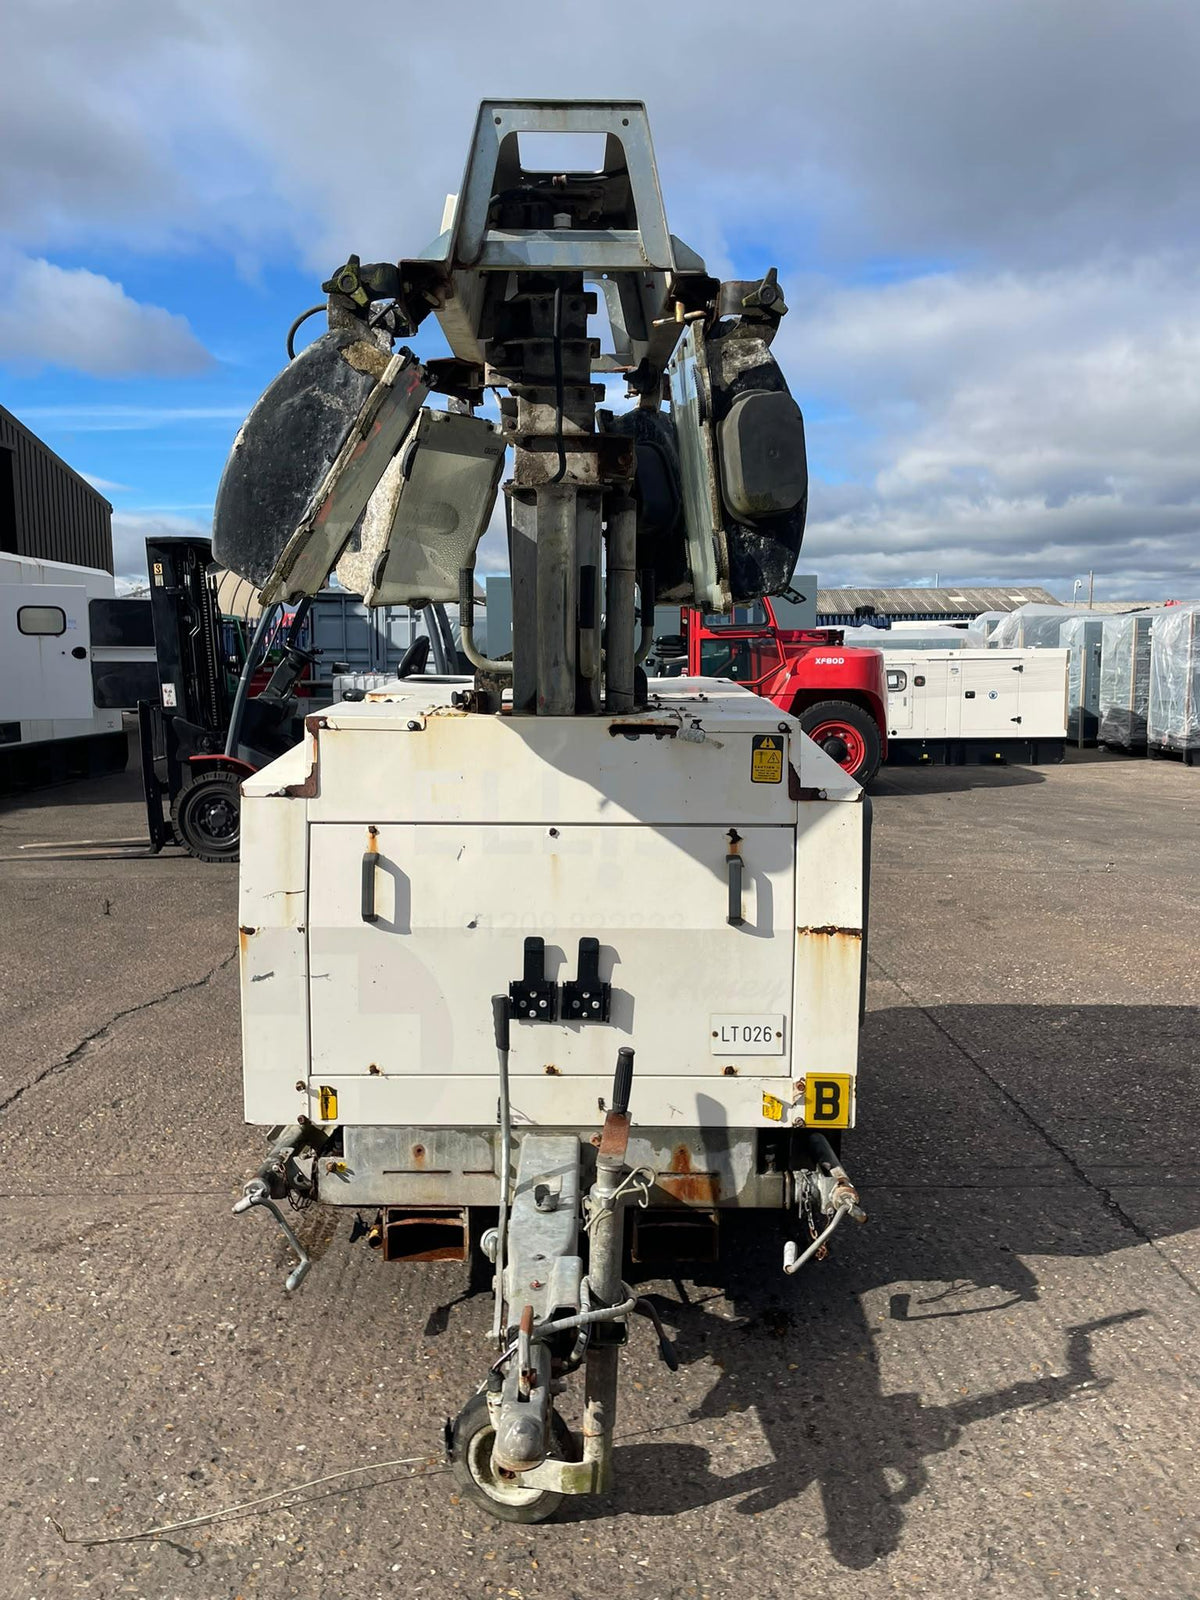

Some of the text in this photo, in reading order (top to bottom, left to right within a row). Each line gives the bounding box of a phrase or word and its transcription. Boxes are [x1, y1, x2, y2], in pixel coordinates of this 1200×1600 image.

[721, 1026, 772, 1042] LT 026
[814, 1081, 841, 1121] B
